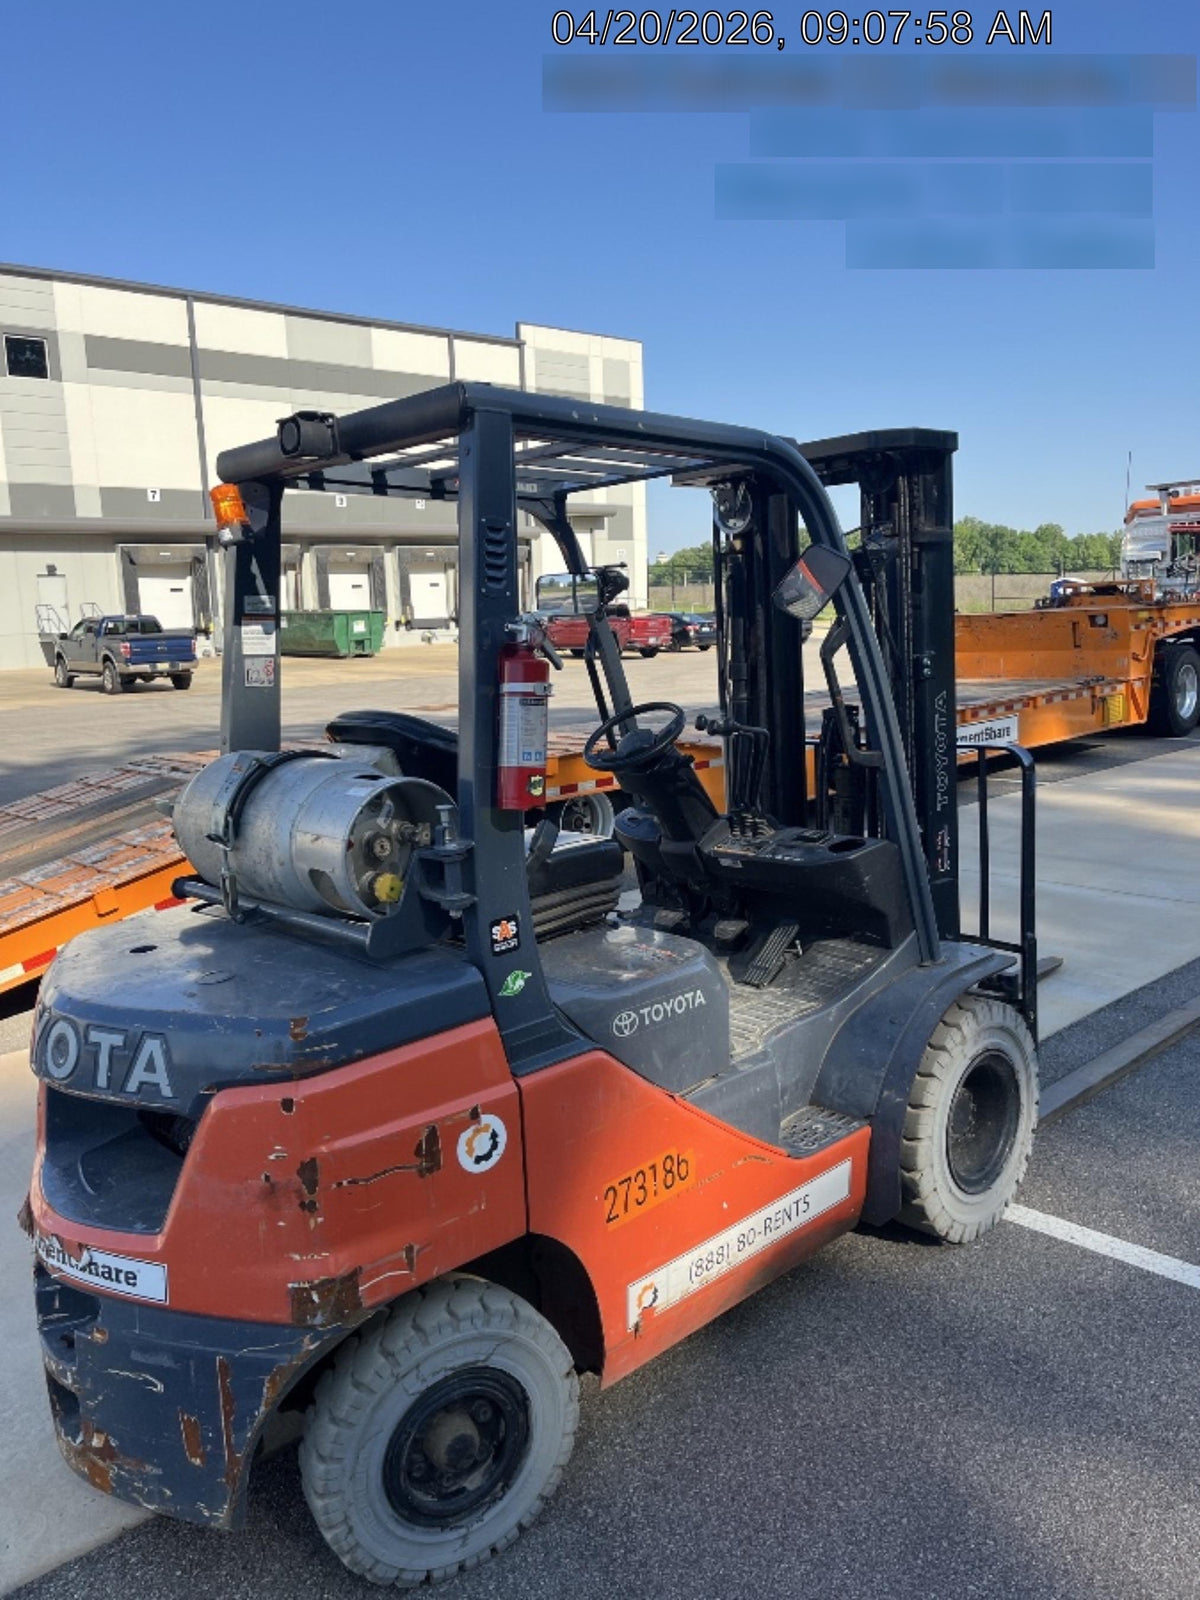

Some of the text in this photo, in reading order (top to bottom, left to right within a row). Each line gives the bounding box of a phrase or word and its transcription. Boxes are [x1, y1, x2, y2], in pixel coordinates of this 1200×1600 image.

[934, 690, 949, 811] TOYOTA
[640, 989, 706, 1025] TOYOTA
[604, 1153, 689, 1224] 273186
[736, 1193, 810, 1253] 80-RENTS
